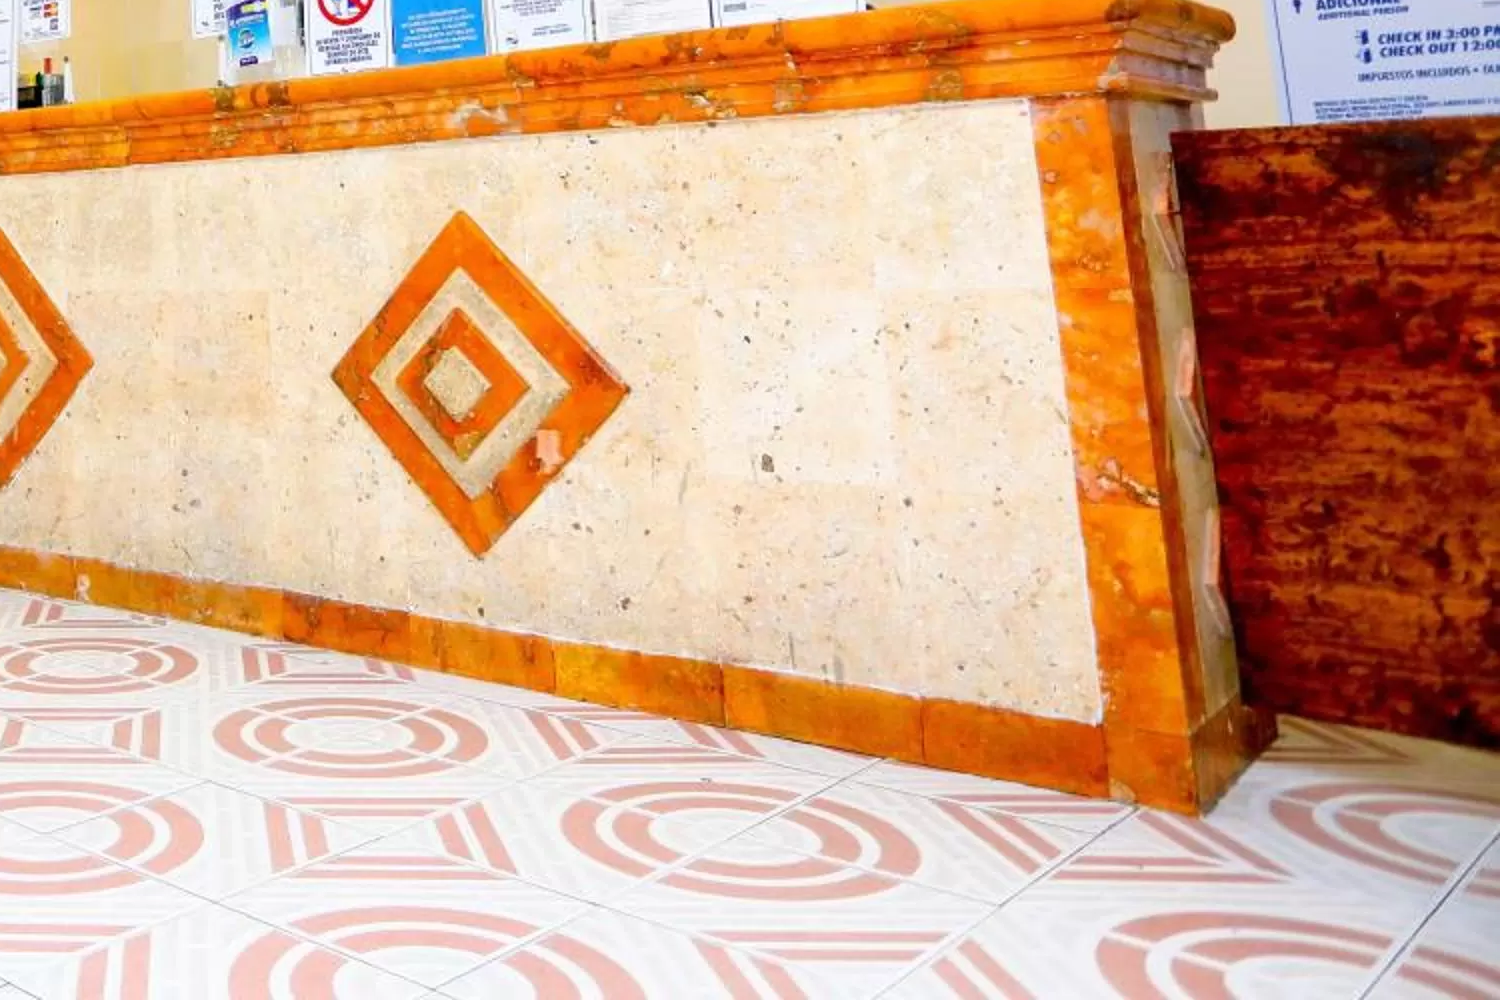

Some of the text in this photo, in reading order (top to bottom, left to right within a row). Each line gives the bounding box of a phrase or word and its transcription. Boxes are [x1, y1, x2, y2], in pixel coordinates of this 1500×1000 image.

[1378, 31, 1421, 45] CHECK
[1426, 29, 1441, 41] IN
[1380, 44, 1424, 58] CHECK
[1428, 41, 1456, 55] OUT
